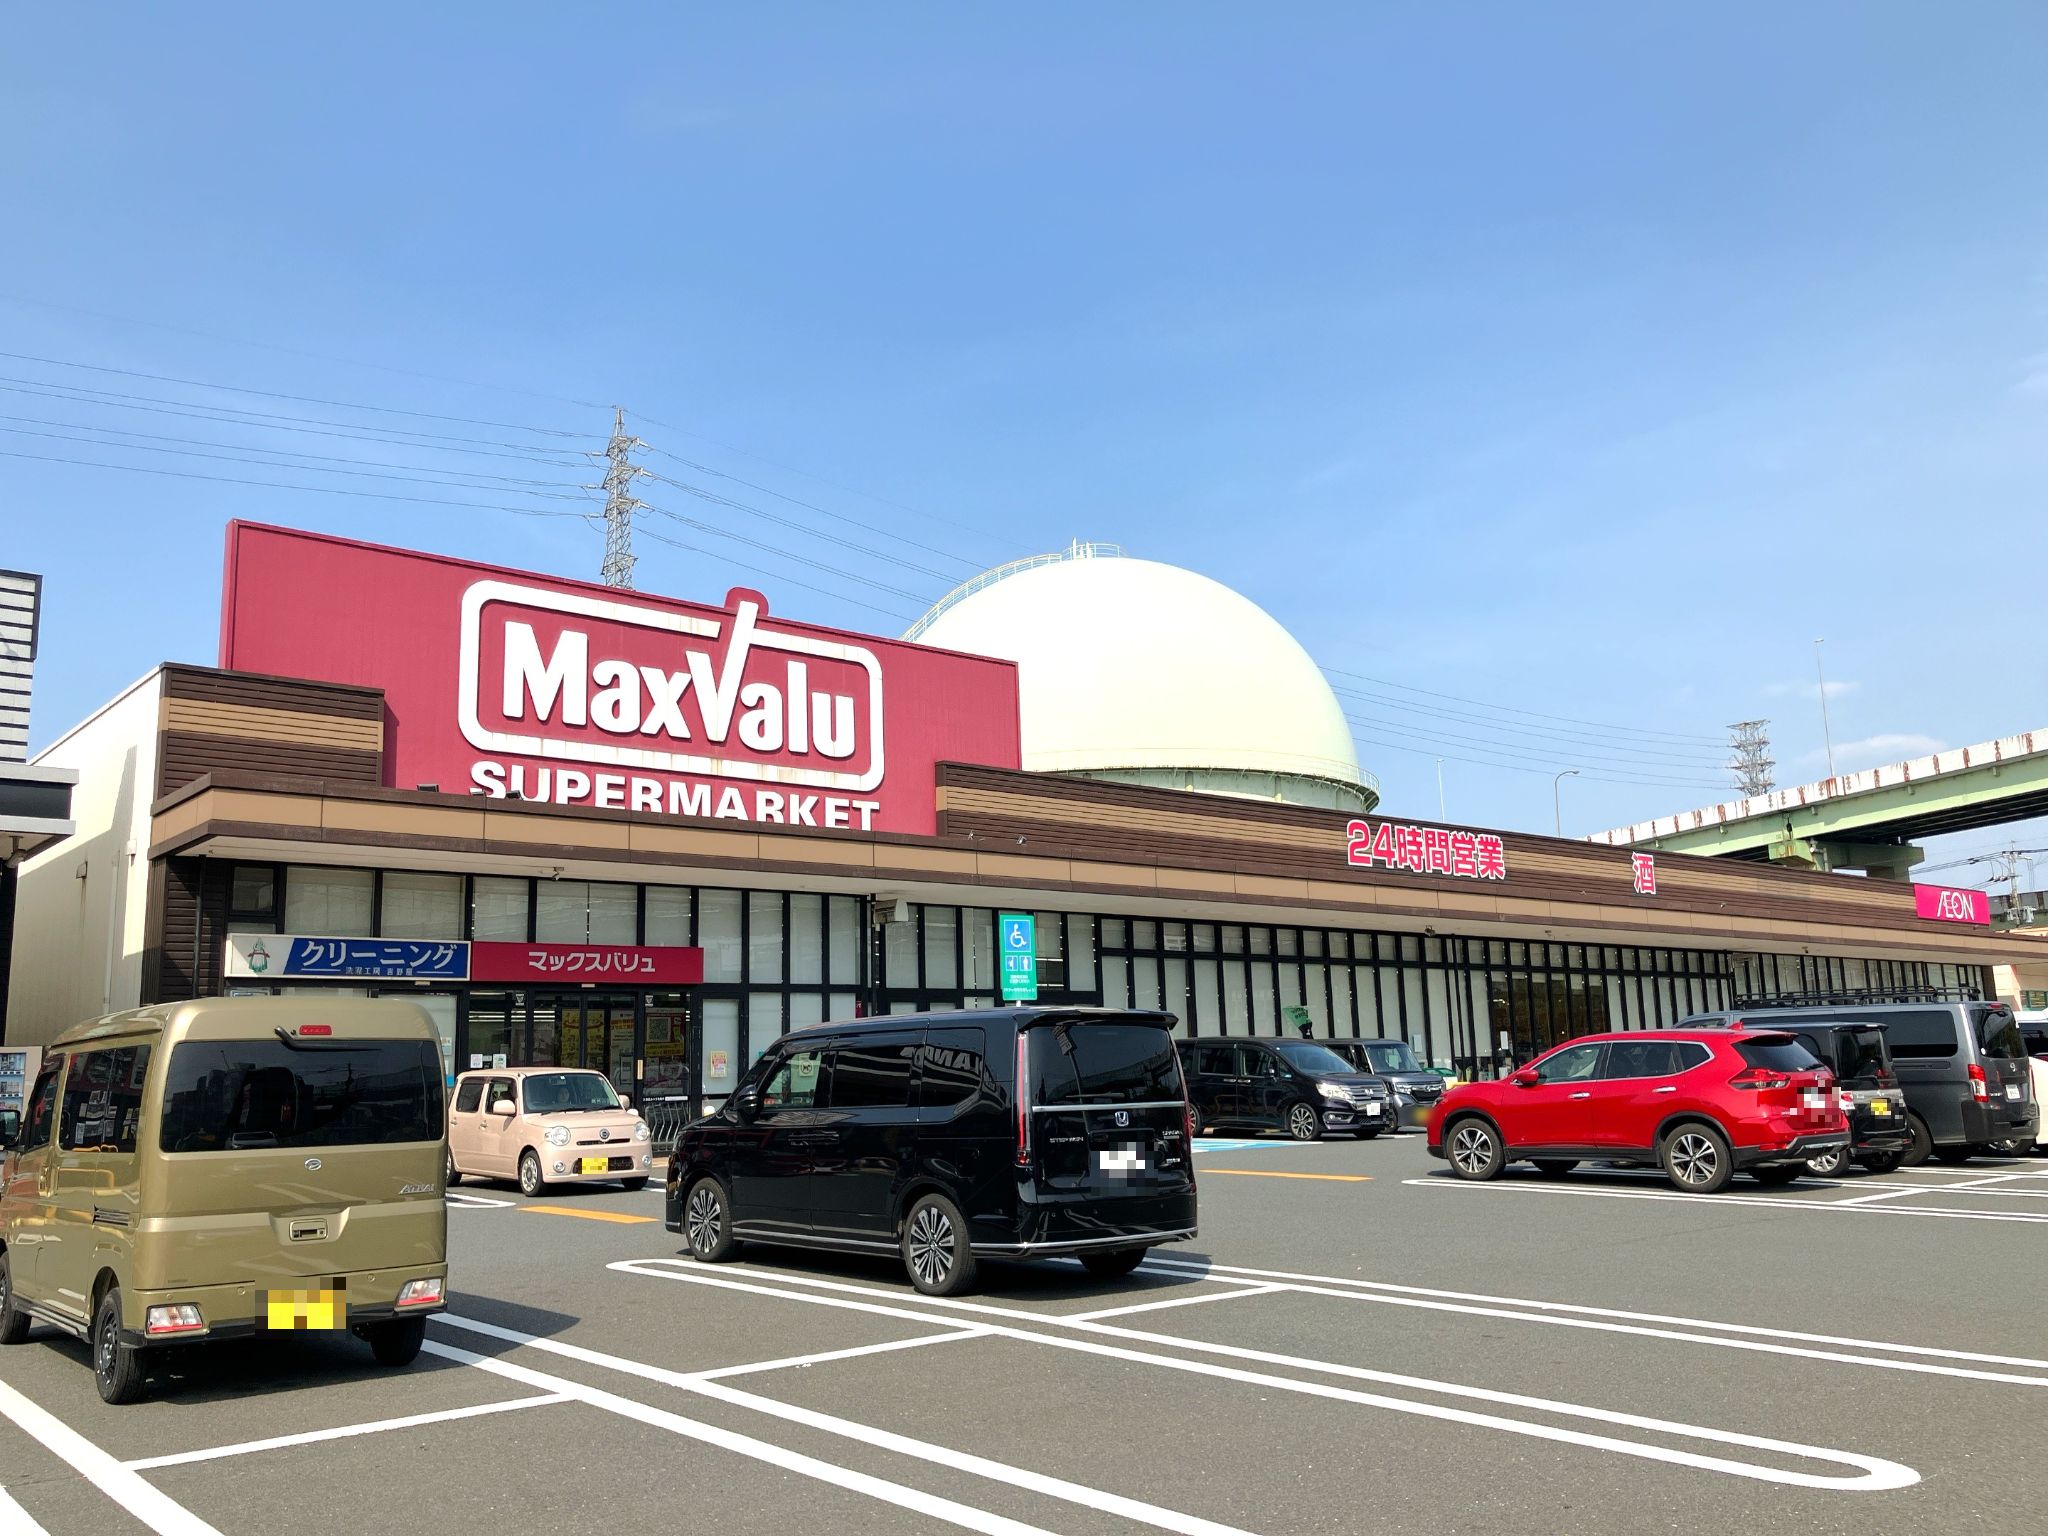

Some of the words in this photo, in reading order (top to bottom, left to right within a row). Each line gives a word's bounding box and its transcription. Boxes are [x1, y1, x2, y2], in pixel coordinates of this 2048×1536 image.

[503, 601, 855, 759] MaxValu
[469, 761, 880, 831] SUPERMARKET
[1346, 819, 1506, 880] 24時間営業
[1631, 851, 1657, 895] 酒
[300, 940, 458, 970] クリーニング
[528, 951, 656, 973] マックスバリュ
